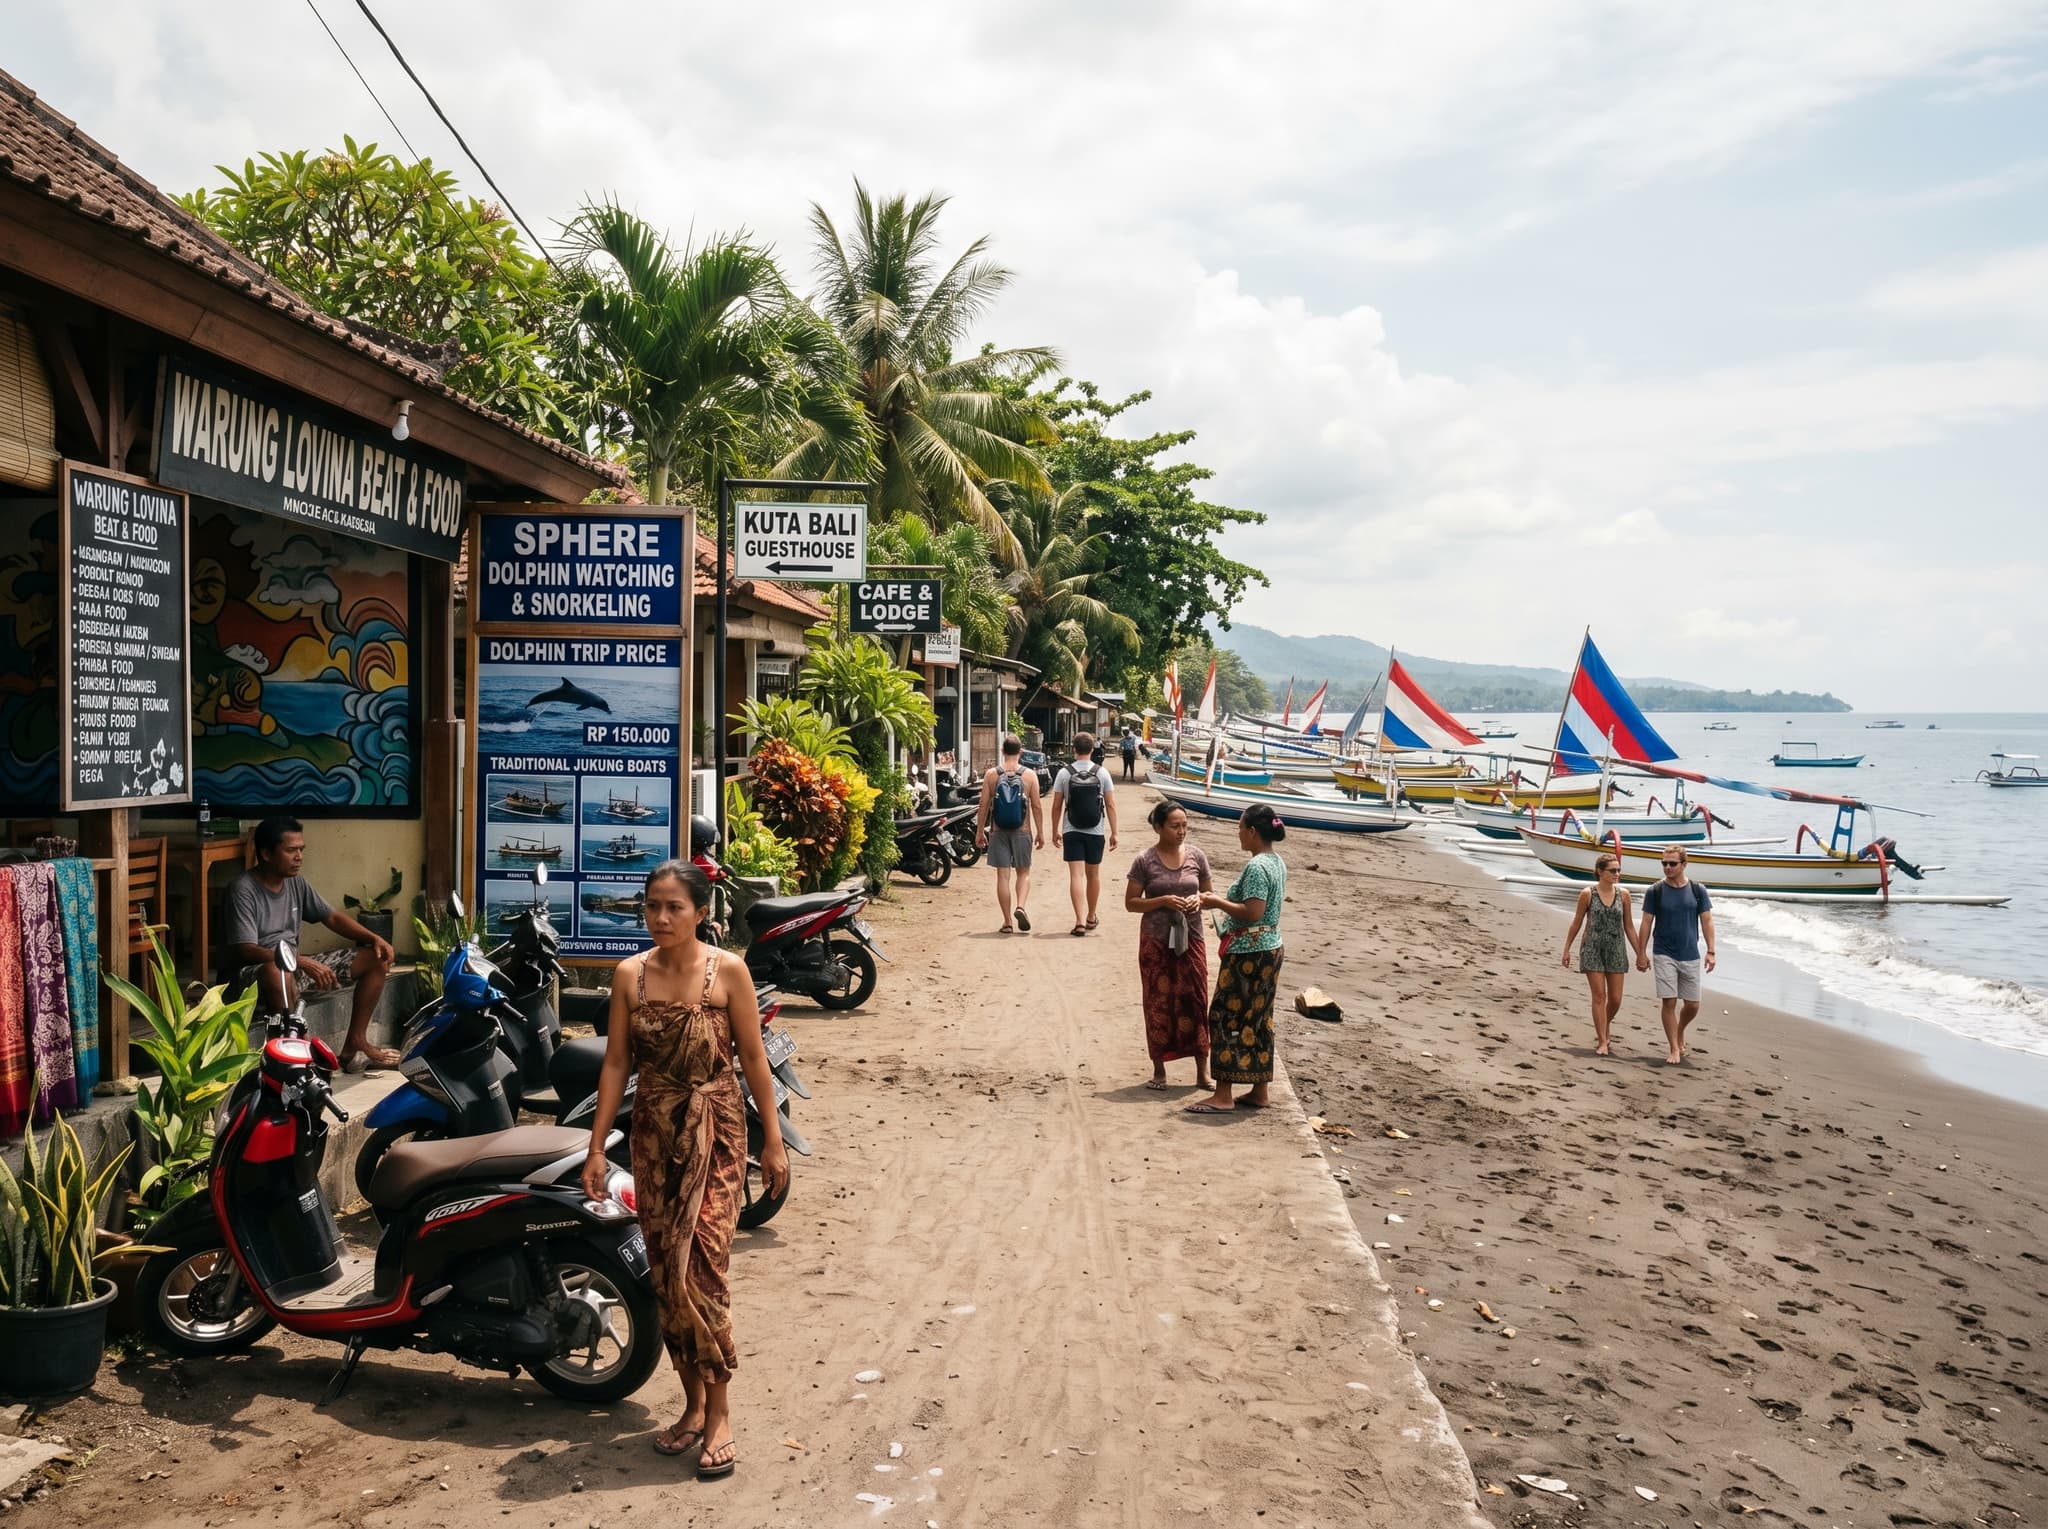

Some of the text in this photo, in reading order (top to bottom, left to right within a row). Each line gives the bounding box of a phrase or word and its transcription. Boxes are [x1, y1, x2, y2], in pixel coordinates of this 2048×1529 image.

[172, 371, 462, 538] WARUNG LOVINA BEAT & FOOD
[74, 478, 177, 526] WARUNG LOVINA
[94, 515, 158, 545] BEAT & FOOD
[744, 511, 856, 536] KUTA BALI
[513, 521, 660, 557] SPHERE
[745, 540, 855, 559] GUESTHOUSE
[488, 561, 675, 588] DOLPHIN WATCHING
[858, 583, 933, 601] CAFE &
[105, 605, 127, 621] FOOD
[511, 591, 651, 618] & SNORKELING
[860, 604, 930, 621] LODGE
[490, 641, 667, 664] DOLPHIN TRIP PRICE
[111, 660, 134, 675] FOOD
[587, 726, 670, 744] RP 150.000
[490, 756, 667, 773] TRADITIONAL JUKUNG BOATS
